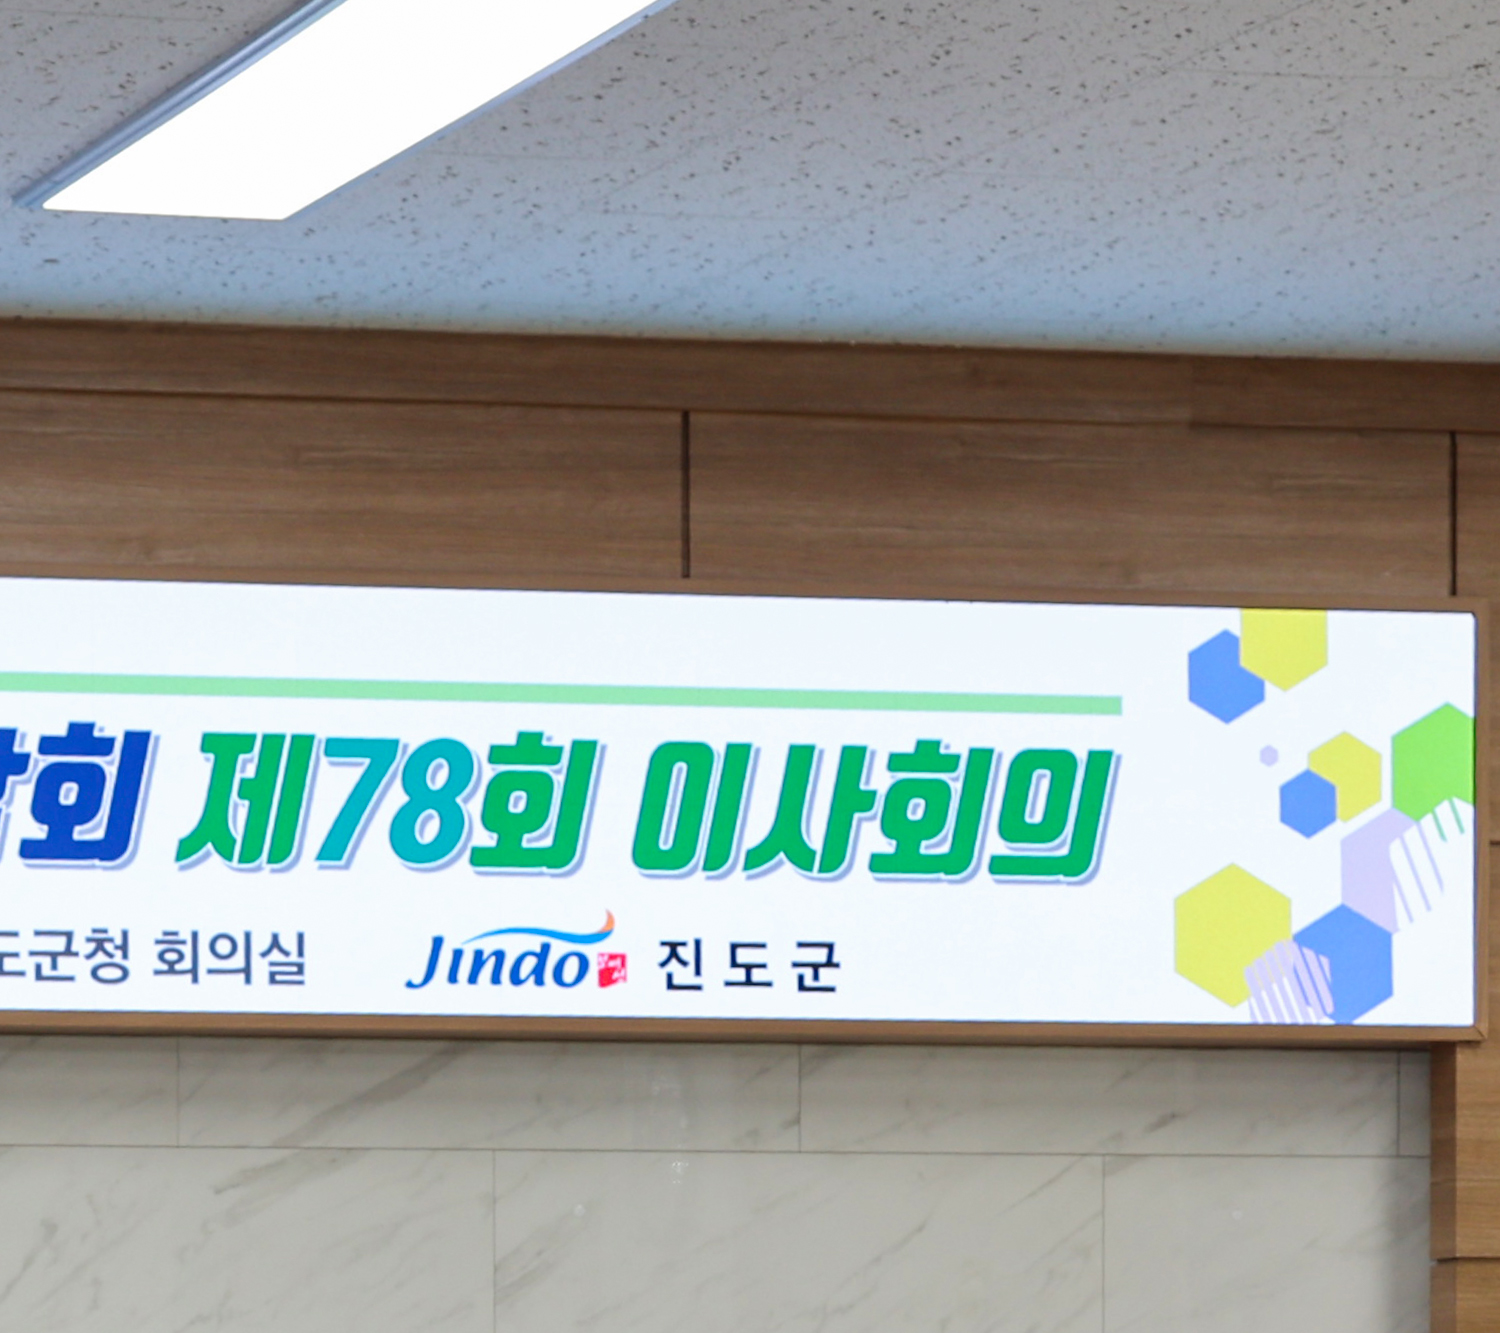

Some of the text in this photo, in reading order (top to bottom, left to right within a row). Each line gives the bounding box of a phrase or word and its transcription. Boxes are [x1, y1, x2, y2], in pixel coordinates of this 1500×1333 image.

[174, 730, 599, 872] 제78회
[631, 738, 1113, 878] 이사회의
[152, 929, 306, 986] 회의실
[404, 935, 590, 989] Jindo
